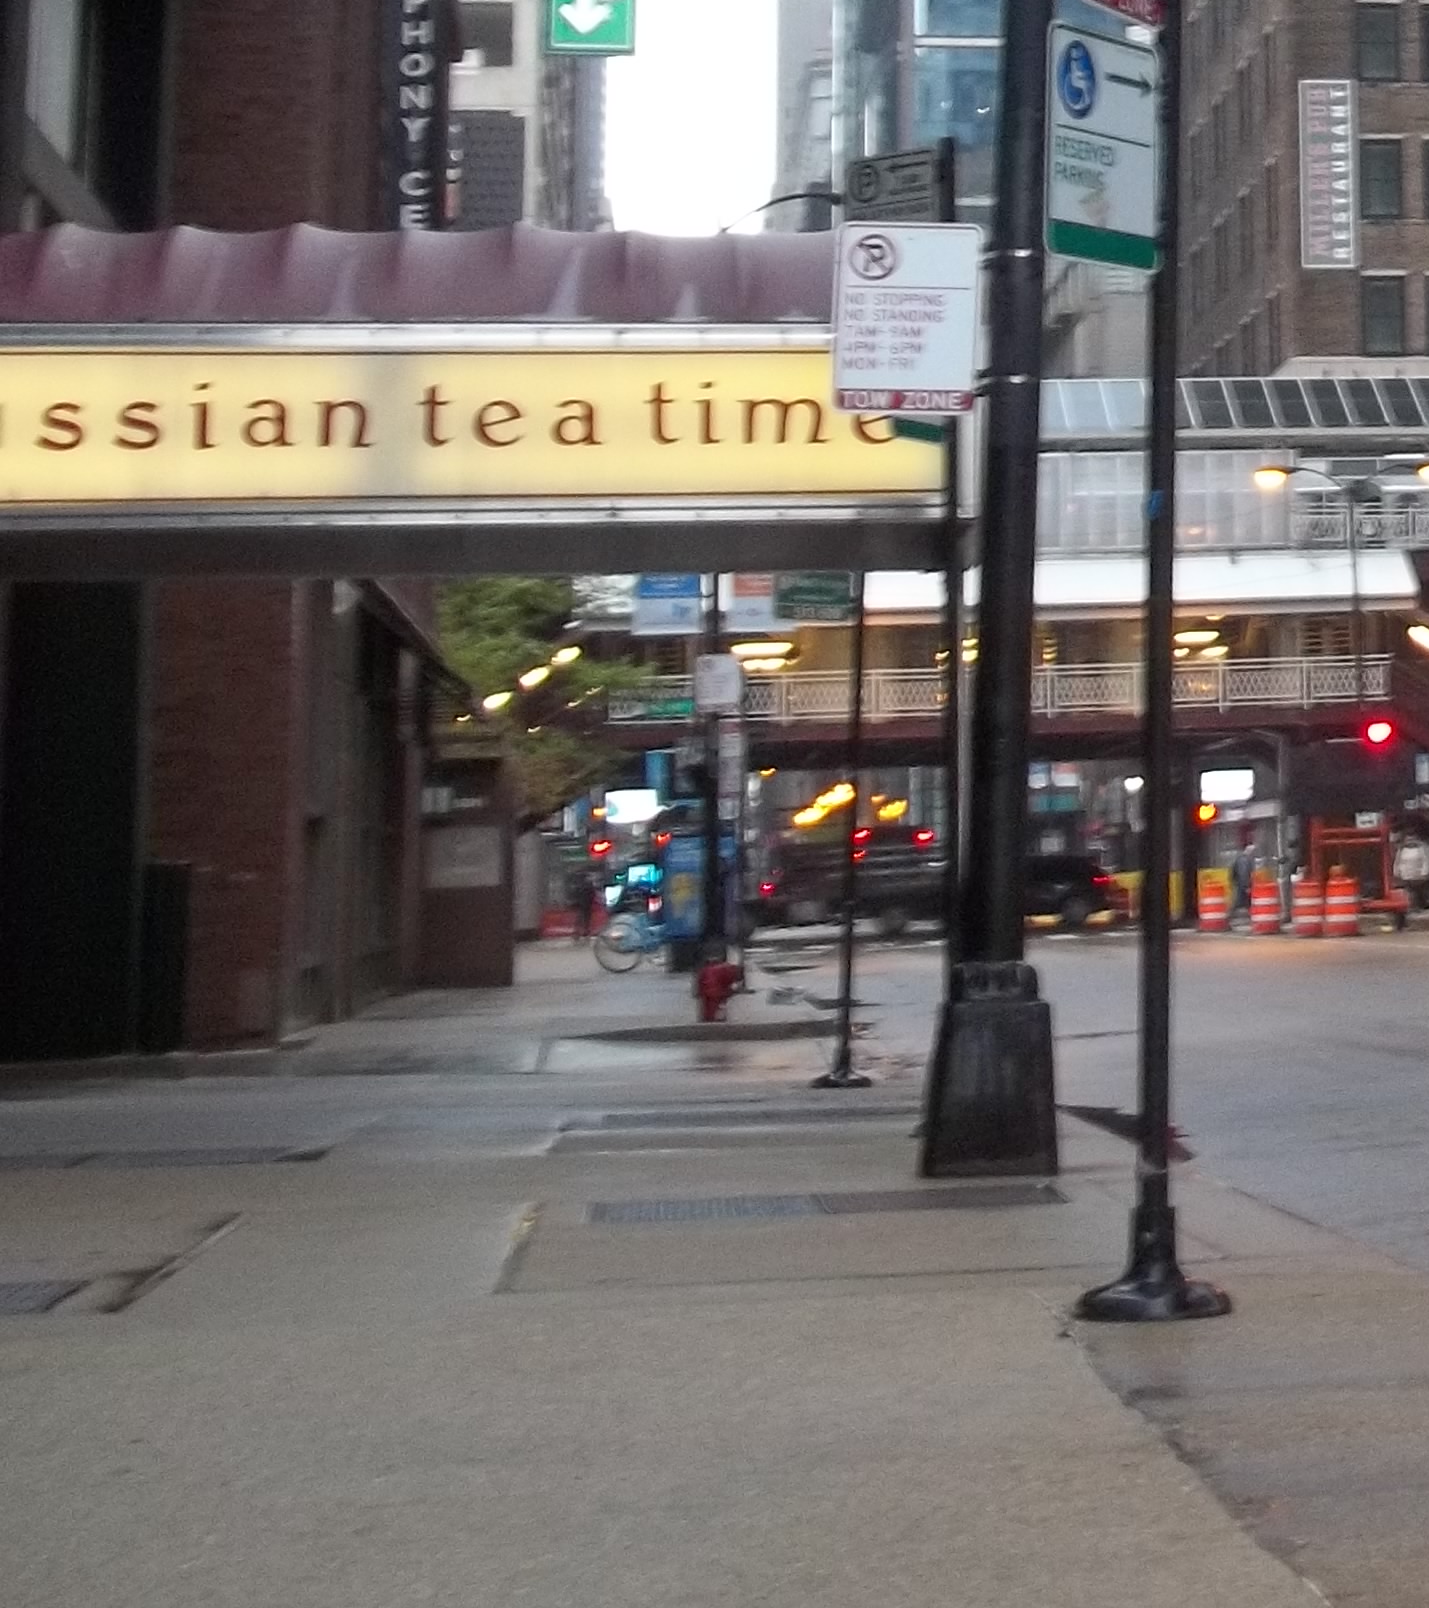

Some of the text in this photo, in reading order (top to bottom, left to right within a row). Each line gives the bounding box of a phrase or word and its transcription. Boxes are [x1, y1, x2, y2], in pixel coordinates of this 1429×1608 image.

[1055, 135, 1115, 167] RESERVED
[1330, 87, 1352, 260] RESTAURANT
[845, 294, 945, 307] NO STOPPING
[844, 309, 945, 323] NO STANDING
[841, 392, 964, 410] TOW ZONE
[0, 380, 899, 451] ssian tea time
